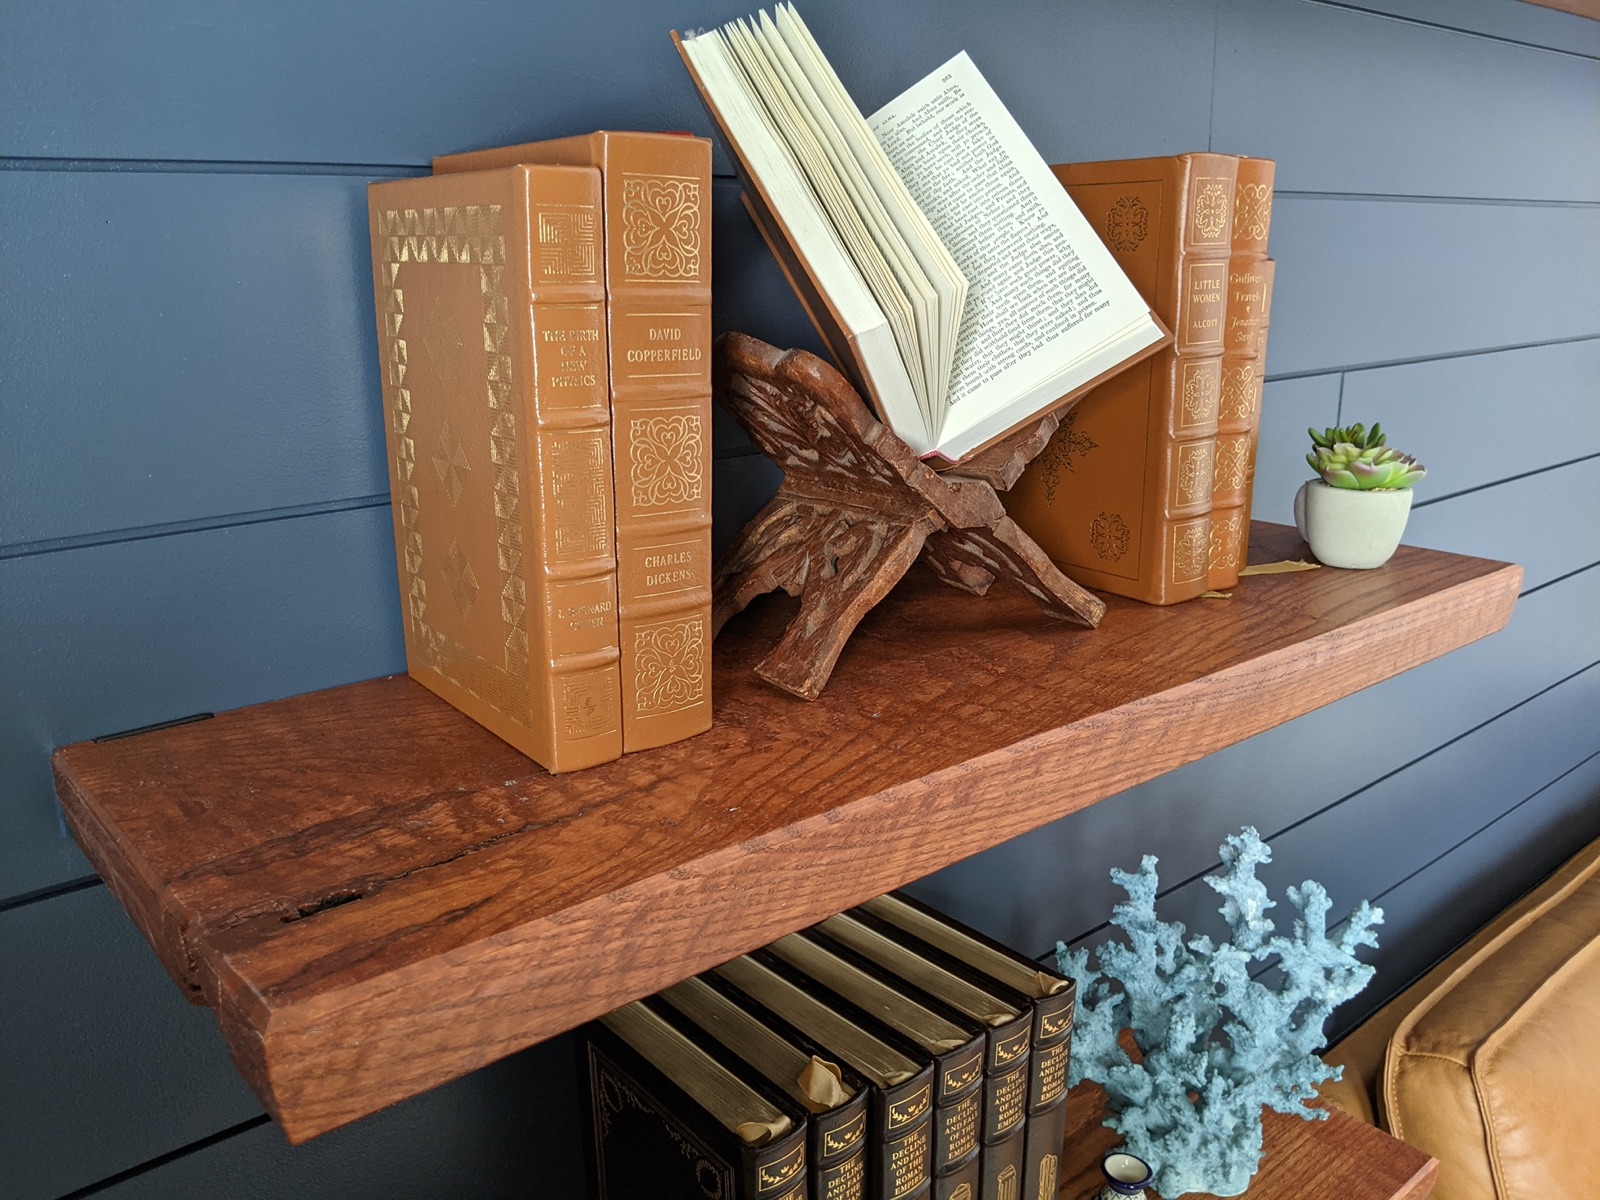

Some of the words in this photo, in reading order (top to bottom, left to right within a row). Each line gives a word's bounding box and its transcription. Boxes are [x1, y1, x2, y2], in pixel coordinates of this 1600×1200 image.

[979, 317, 993, 329] How
[994, 307, 1009, 319] shall
[1017, 293, 1032, 303] look
[1032, 283, 1048, 294] when
[1057, 270, 1067, 278] are
[1068, 258, 1082, 271] dam-
[1194, 279, 1220, 290] LITTLE
[964, 336, 977, 348] such
[976, 325, 997, 338] things,
[997, 317, 1009, 327] yea,
[1009, 309, 1017, 318] all
[1017, 296, 1038, 312] manner
[1038, 290, 1045, 298] of
[1045, 283, 1059, 294] such
[1058, 272, 1076, 287] things
[1076, 264, 1086, 274] did
[1193, 293, 1221, 304] WOMEN
[960, 355, 972, 366] they
[973, 347, 983, 357] did
[983, 331, 1008, 350] withhold
[1007, 323, 1021, 334] food
[1020, 315, 1035, 325] from
[1035, 305, 1052, 316] them,
[1051, 296, 1064, 306] that
[1064, 287, 1078, 298] they
[1077, 276, 1096, 290] might
[961, 344, 979, 357] them;
[980, 334, 991, 344] and
[991, 326, 1004, 337] thus
[1004, 318, 1019, 331] they
[1018, 310, 1028, 319] did
[1029, 300, 1046, 312] mock
[1046, 290, 1063, 301] them,
[1063, 282, 1072, 290] for
[1074, 271, 1090, 284] many
[1193, 319, 1218, 329] ALCOTT
[542, 330, 566, 342] THE
[569, 329, 599, 341] BIRTH
[649, 328, 681, 341] DAVID
[951, 369, 963, 379] and
[963, 359, 982, 371] water,
[982, 349, 993, 359] that
[995, 340, 1008, 353] they
[1008, 328, 1027, 344] might
[1026, 316, 1046, 330] thirst;
[1047, 306, 1059, 317] and
[1060, 298, 1073, 308] they
[1074, 290, 1086, 300] also
[1088, 281, 1098, 291] did
[961, 369, 976, 380] them
[976, 360, 990, 371] their
[991, 346, 1013, 361] clothes,
[1013, 337, 1025, 346] that
[1025, 328, 1038, 339] they
[1039, 319, 1053, 330] were
[1054, 303, 1076, 321] naked;
[1077, 296, 1088, 306] and
[1088, 288, 1102, 298] thus
[579, 345, 586, 357] A
[627, 348, 702, 363] COPPERFIELD
[949, 395, 960, 406] And
[966, 382, 981, 394] came
[989, 368, 1002, 380] pass
[1003, 358, 1016, 370] after
[1018, 349, 1031, 360] they
[1031, 340, 1043, 351] had
[1045, 332, 1059, 342] thus
[1060, 314, 1083, 333] suffered
[1083, 310, 1092, 318] for
[1093, 300, 1109, 312] many
[951, 385, 964, 396] were
[964, 372, 983, 387] bound
[983, 364, 996, 374] with
[997, 352, 1015, 365] strong
[1015, 341, 1033, 354] cords,
[1033, 331, 1045, 342] and
[1045, 316, 1069, 334] confined
[1077, 301, 1097, 317] prison.
[551, 374, 596, 388] PHYSICS
[644, 550, 692, 569] CHARLES
[646, 569, 692, 587] DICKENS
[1042, 1048, 1068, 1068] DECLINE
[1051, 1045, 1063, 1056] THE
[1007, 1071, 1020, 1083] THE
[1039, 1067, 1054, 1077] AND
[1056, 1058, 1068, 1071] FALL
[1054, 1067, 1065, 1079] THE
[996, 1074, 1025, 1096] DECLINE
[1041, 1083, 1064, 1101] EMPIRE
[1042, 1075, 1064, 1092] ROMAN
[995, 1094, 1011, 1105] AND
[1012, 1083, 1025, 1098] FALL
[1000, 1103, 1009, 1112] OF
[1011, 1093, 1022, 1105] THE
[946, 1102, 977, 1125] DECLINE
[957, 1099, 970, 1111] THE
[999, 1101, 1022, 1121] ROMAN
[945, 1123, 962, 1135] AND
[963, 1111, 978, 1126] FALL
[997, 1109, 1022, 1129] EMPIRE
[903, 1132, 919, 1146] THE
[950, 1132, 960, 1141] OF
[962, 1121, 975, 1135] THE
[950, 1130, 975, 1150] ROMAN
[891, 1156, 909, 1170] AND
[910, 1144, 927, 1158] FALL
[892, 1135, 926, 1160] DECLINE
[948, 1138, 975, 1159] EMPIRE
[828, 1161, 864, 1188] DECLINE
[840, 1158, 855, 1174] THE
[895, 1164, 923, 1186] ROMAN
[896, 1166, 907, 1177] OF
[909, 1155, 923, 1170] THE
[826, 1184, 846, 1199] AND
[847, 1170, 864, 1188] FALL
[845, 1182, 860, 1198] THE
[895, 1172, 923, 1195] EMPIRE
